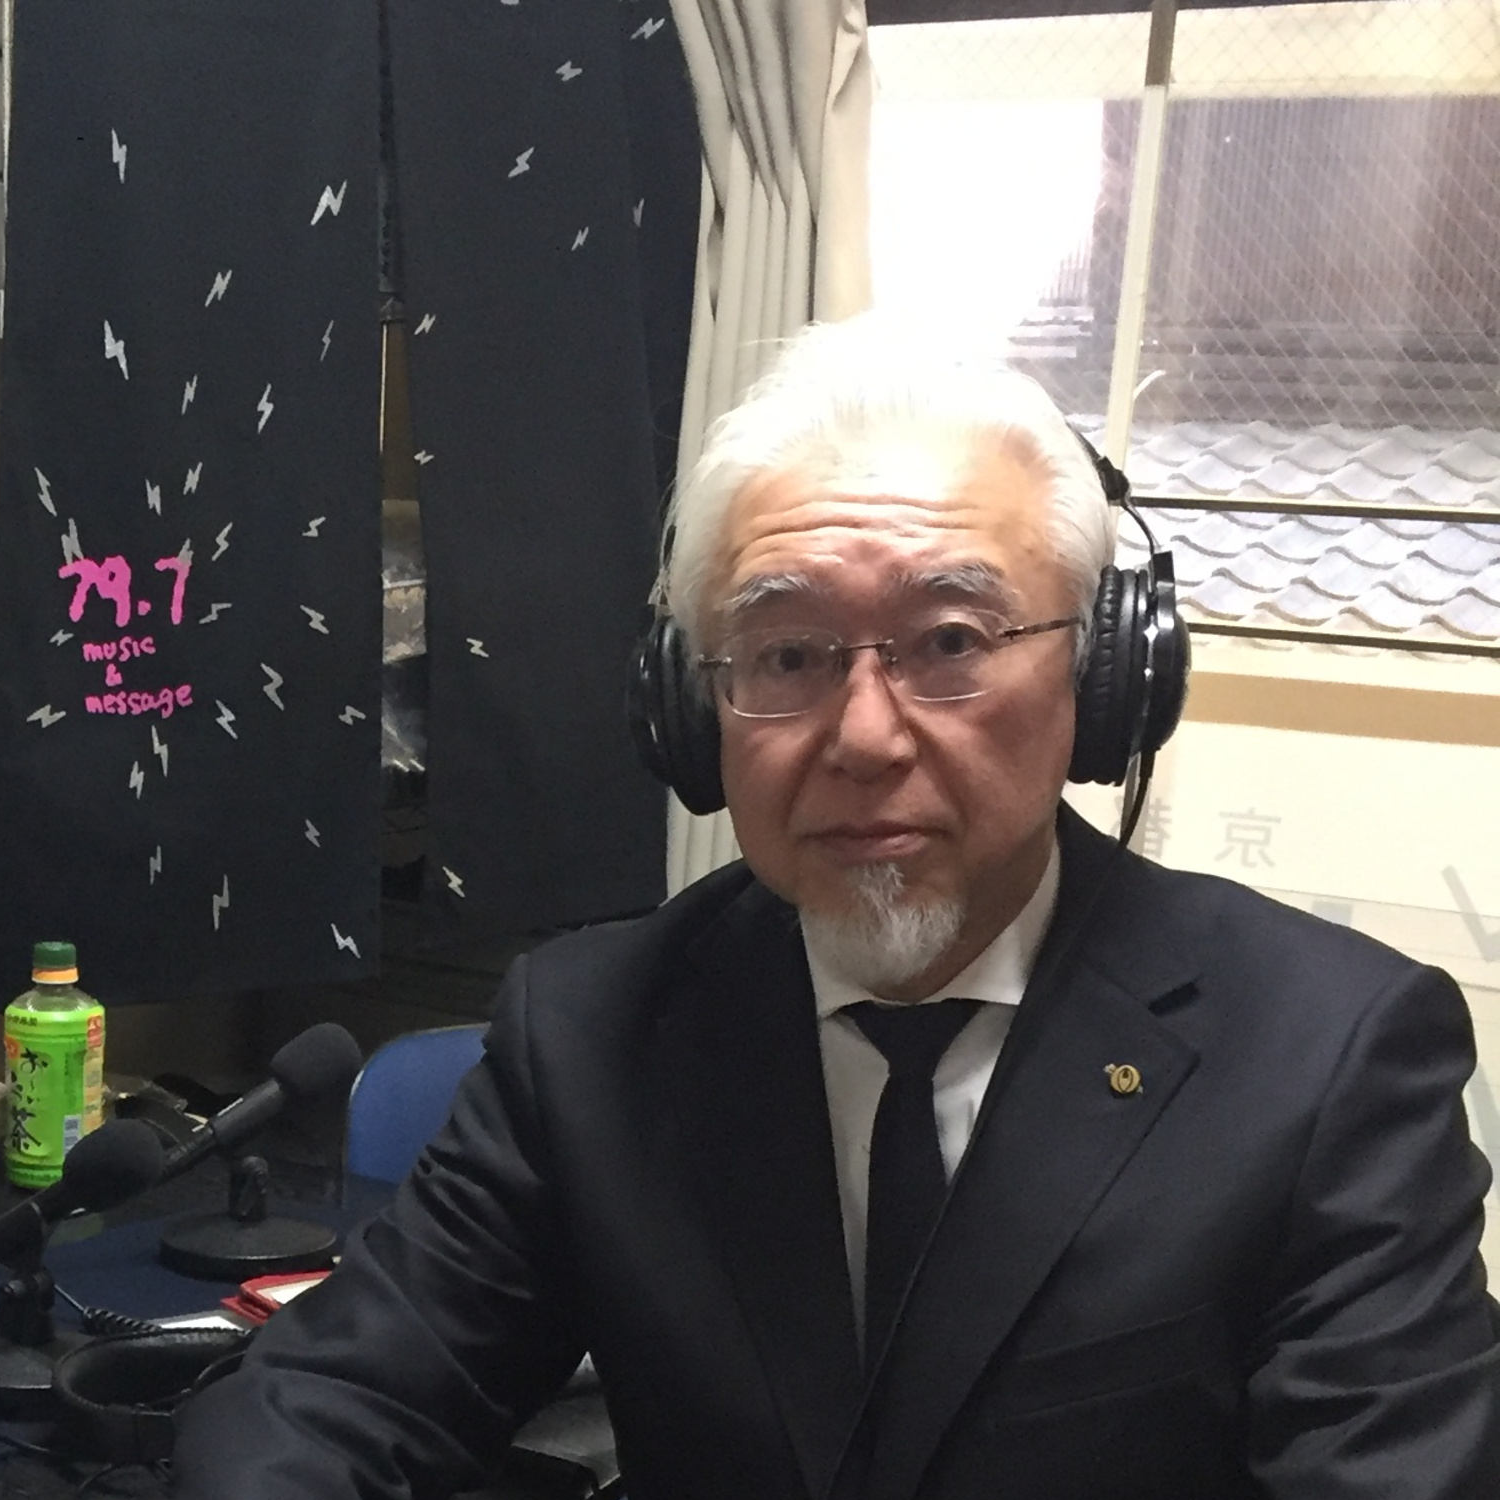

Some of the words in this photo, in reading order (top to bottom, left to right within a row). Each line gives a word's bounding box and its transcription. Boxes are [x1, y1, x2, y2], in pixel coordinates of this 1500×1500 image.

[58, 555, 193, 628] 79.7
[82, 636, 156, 663] music
[105, 663, 123, 687] &
[85, 684, 193, 719] message
